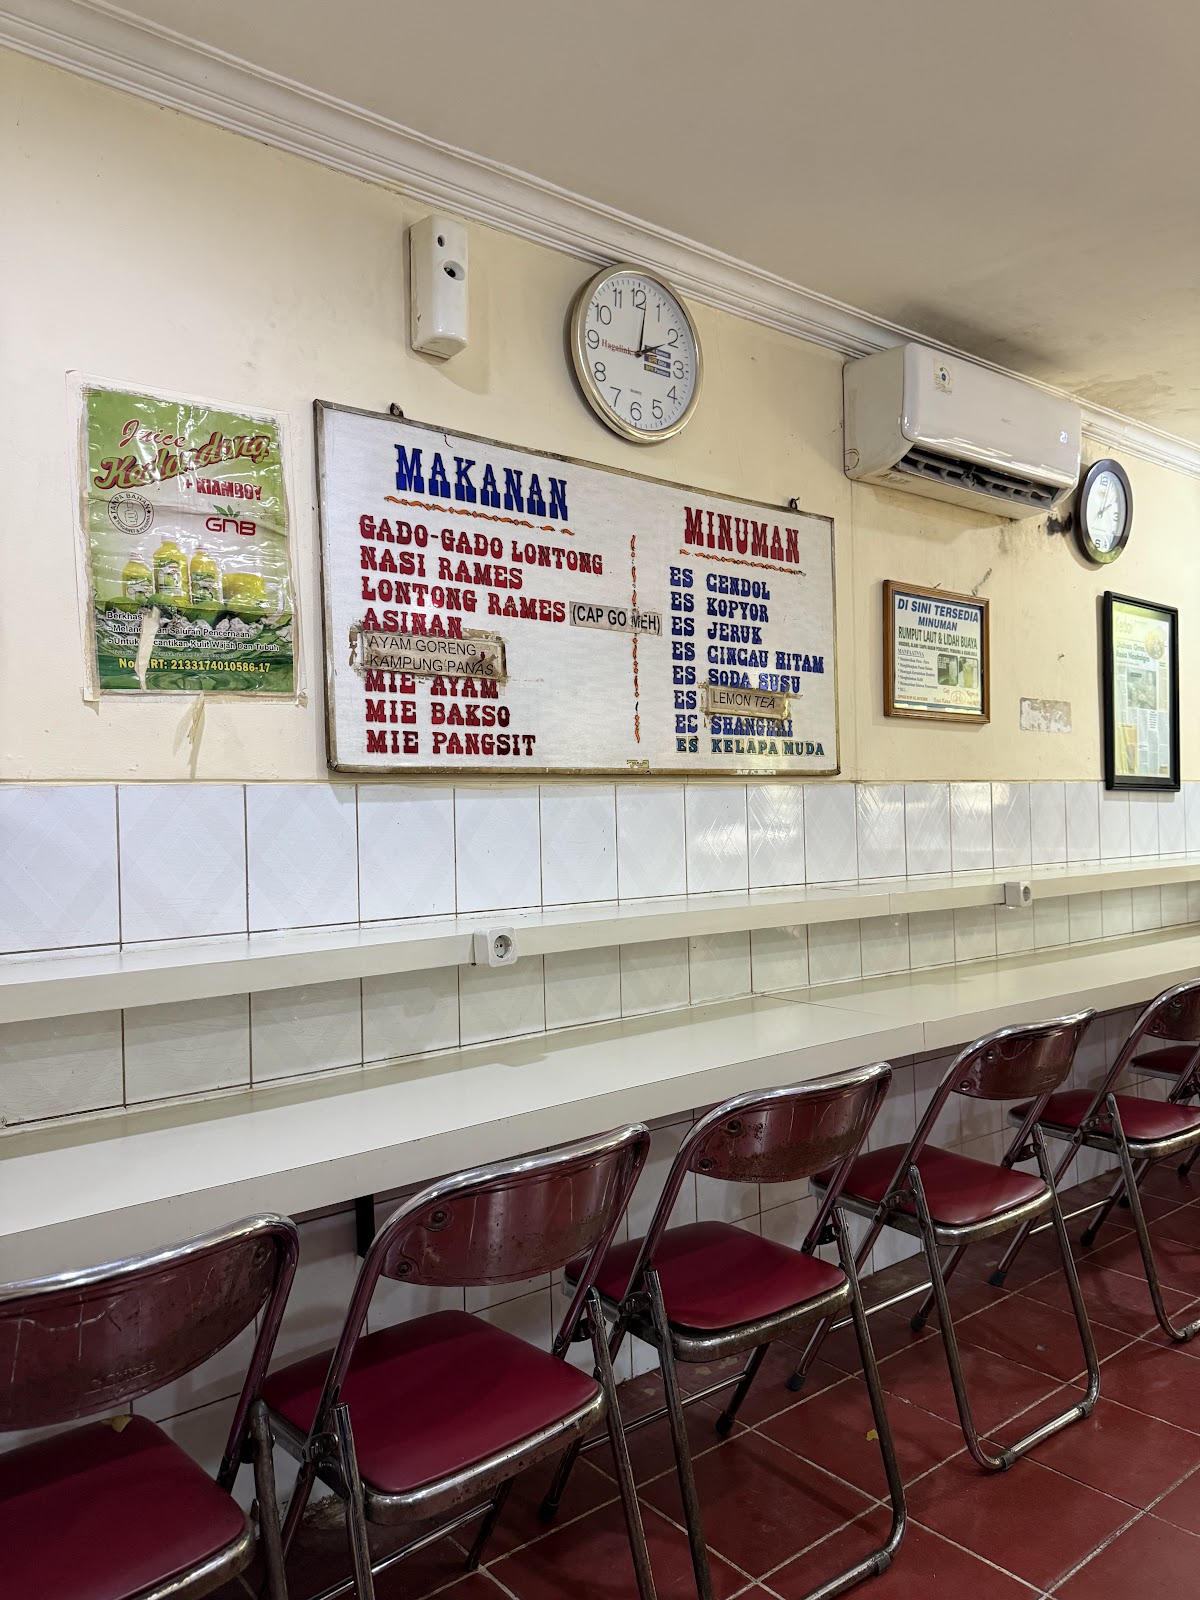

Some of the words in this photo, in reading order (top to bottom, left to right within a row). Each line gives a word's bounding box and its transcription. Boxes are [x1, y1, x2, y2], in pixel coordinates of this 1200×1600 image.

[613, 288, 622, 308] 11
[631, 288, 646, 310] 12
[595, 303, 612, 325] 10
[656, 304, 660, 322] 1
[588, 330, 600, 350] 9
[668, 328, 679, 348] 2
[594, 362, 606, 382] 8
[673, 360, 684, 379] 3
[610, 386, 622, 407] 7
[666, 386, 678, 404] 4
[631, 402, 642, 421] 6
[652, 399, 664, 419] 5
[119, 420, 188, 448] Juice
[196, 478, 263, 500] KIAMBOY
[394, 444, 568, 521] MAKANAN
[110, 494, 124, 514] TANPA
[126, 494, 150, 510] BAHAN
[359, 514, 504, 558] GADO-GADO
[512, 541, 603, 575] LONTONG
[684, 506, 800, 564] MINUMAN
[360, 546, 426, 578] NASI
[438, 556, 523, 590] RAMES
[670, 566, 694, 588] ES
[706, 573, 770, 600] CENDOL
[362, 576, 478, 612] LONTONG
[488, 593, 566, 622] RAMES
[573, 604, 604, 624] (CAP
[608, 610, 626, 626] GO
[670, 592, 694, 612] ES
[707, 597, 769, 622] KOPYOR
[898, 598, 908, 610] DI
[911, 601, 931, 614] SINI
[935, 605, 978, 623] TERSEDIA
[108, 612, 143, 620] Berkhas
[362, 608, 462, 639] ASINAN
[918, 616, 957, 631] MINUMAN
[113, 625, 167, 634] Melancan
[169, 627, 202, 636] Saluran
[204, 629, 250, 638] Pencernaan
[672, 616, 694, 637] ES
[708, 622, 762, 645] JERUK
[899, 626, 922, 641] RUMPUT
[924, 630, 937, 644] LAUT
[938, 632, 942, 644] &
[944, 633, 959, 647] LIDAH
[961, 636, 978, 650] BUAYA
[190, 640, 210, 648] Kulit
[212, 642, 236, 650] Wajah
[237, 642, 252, 650] Dan
[255, 643, 279, 651] Tubuh
[369, 636, 411, 650] AYAM
[416, 640, 476, 656] GORENG
[171, 659, 270, 672] 2133174010586-17
[370, 655, 443, 672] KAMPUNG
[448, 660, 494, 675] PANAS
[672, 641, 695, 662] ES
[708, 645, 769, 669] CINCAU
[776, 652, 824, 673] HITAM
[365, 669, 416, 694] MIE
[431, 675, 498, 699] AYAM
[673, 666, 696, 685] ES
[708, 669, 750, 689] SODA
[758, 673, 801, 693] SUSU
[674, 690, 697, 709] ES
[713, 692, 750, 706] LEMON
[755, 695, 775, 708] TEA
[365, 699, 417, 723] MIE
[432, 701, 510, 727] BAKSO
[675, 714, 698, 733] ES
[711, 716, 793, 737] SHANGHAI
[366, 730, 418, 754] MIE
[433, 732, 536, 756] PANGSIT
[676, 737, 698, 753] ES
[711, 738, 778, 755] KELAPA
[783, 741, 824, 756] MUDA
